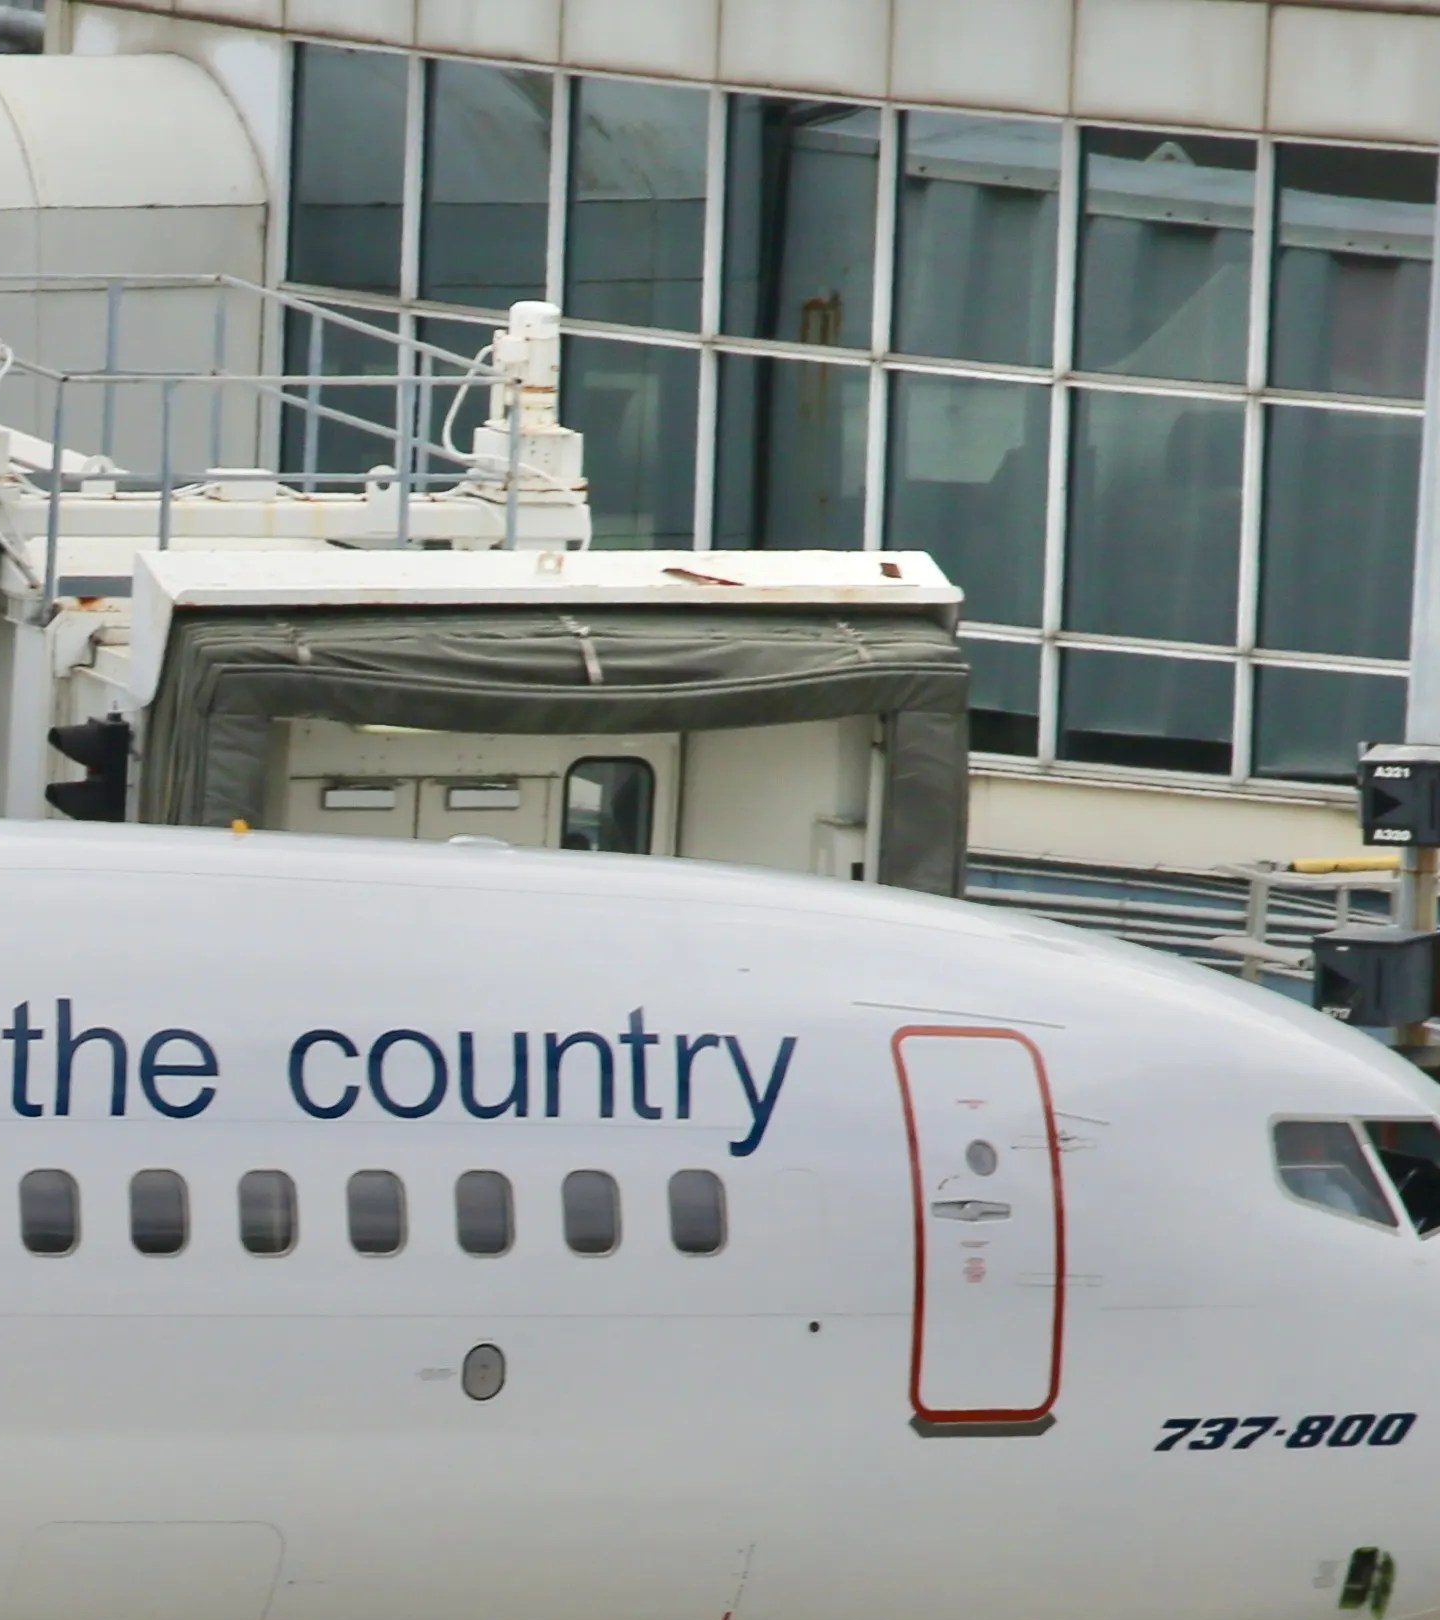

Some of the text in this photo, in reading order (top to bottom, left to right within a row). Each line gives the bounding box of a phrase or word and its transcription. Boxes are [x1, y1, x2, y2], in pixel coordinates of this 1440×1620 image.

[1, 998, 221, 1121] the
[287, 1008, 799, 1158] country
[1152, 1411, 1419, 1452] 737-800
